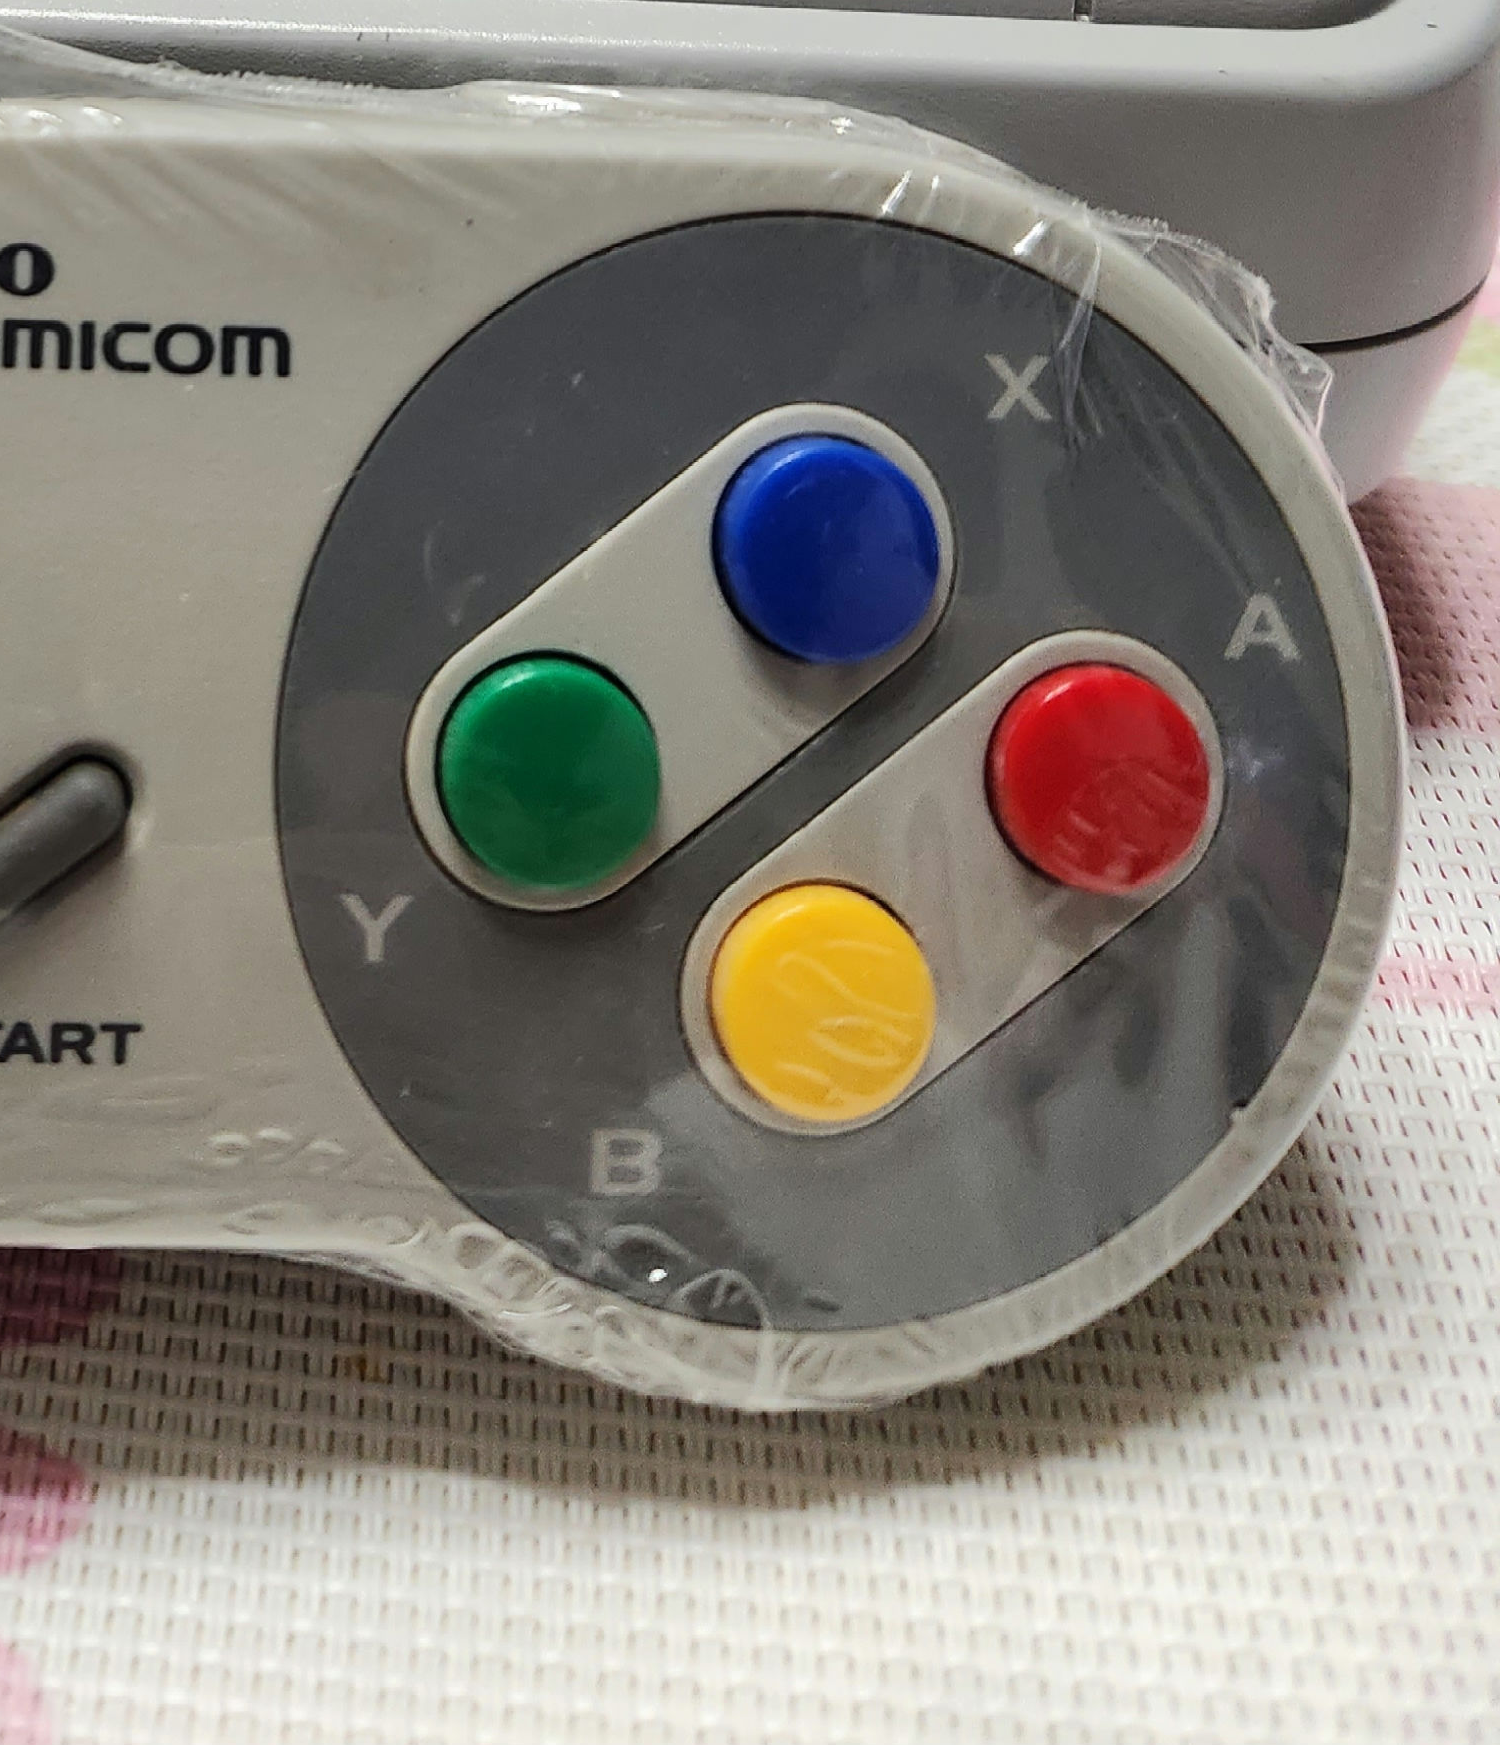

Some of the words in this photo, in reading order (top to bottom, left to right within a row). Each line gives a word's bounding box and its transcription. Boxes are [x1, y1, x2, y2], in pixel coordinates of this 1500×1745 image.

[984, 353, 1053, 422] X
[1224, 595, 1298, 660] A
[339, 893, 415, 964] Y
[588, 1128, 663, 1197] B
